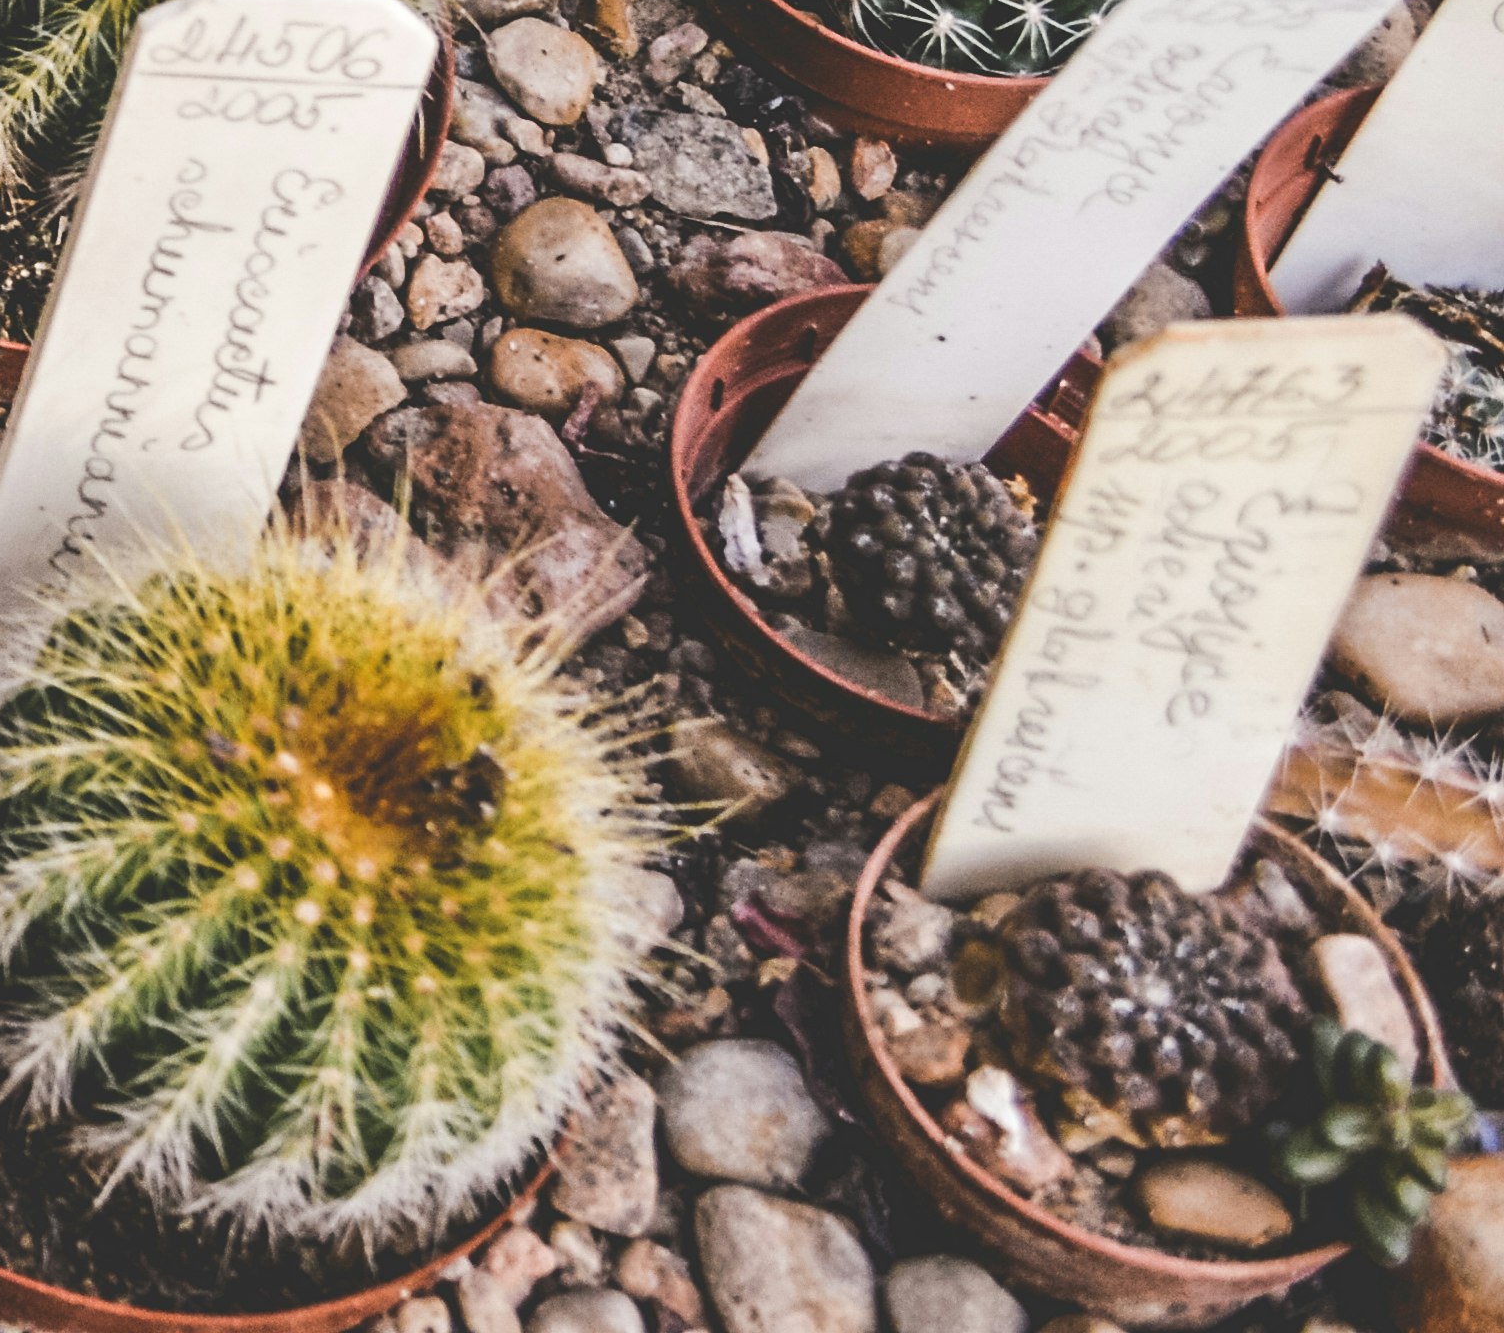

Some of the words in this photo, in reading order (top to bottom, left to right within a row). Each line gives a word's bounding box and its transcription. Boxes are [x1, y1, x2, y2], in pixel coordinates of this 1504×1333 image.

[147, 12, 389, 90] 24506
[174, 70, 366, 135] 2005.
[177, 166, 345, 452] Eriocactus
[1096, 409, 1350, 465] 2005
[1135, 480, 1367, 729] Eriosyce
